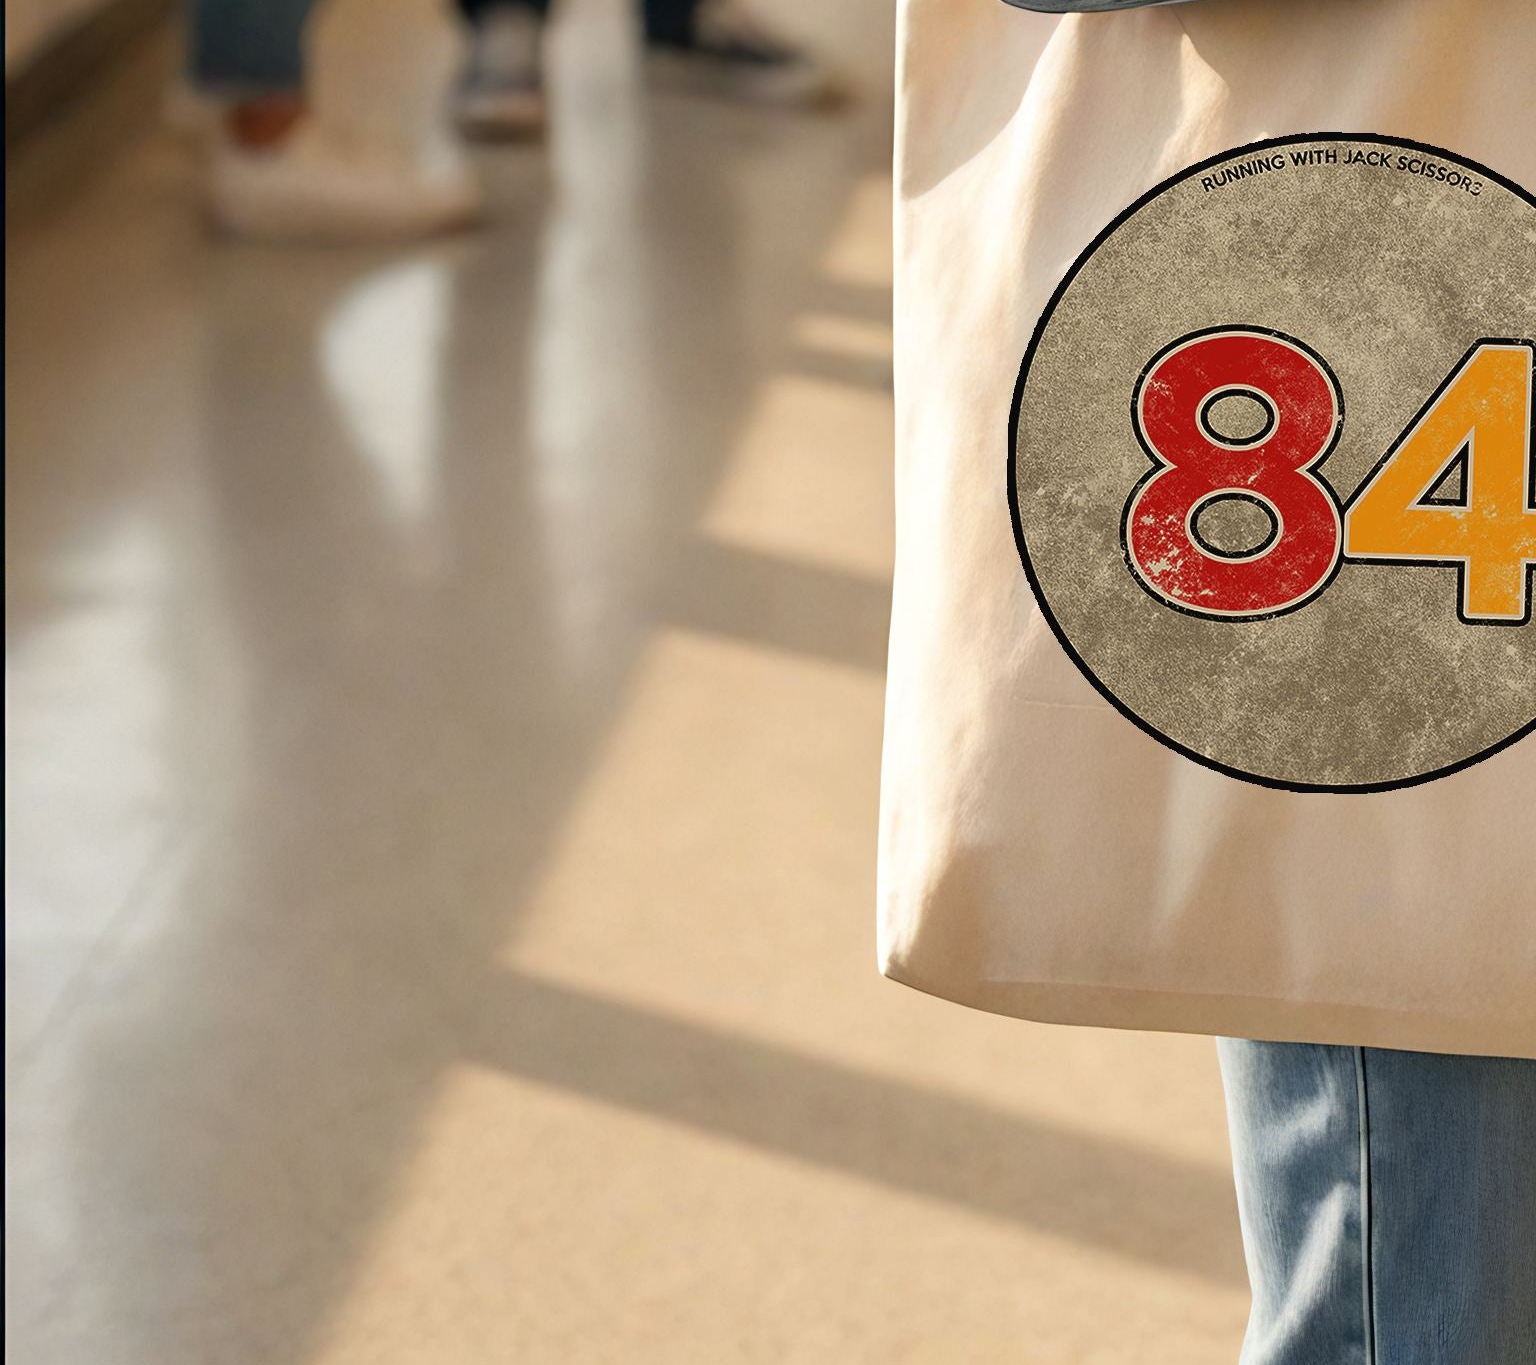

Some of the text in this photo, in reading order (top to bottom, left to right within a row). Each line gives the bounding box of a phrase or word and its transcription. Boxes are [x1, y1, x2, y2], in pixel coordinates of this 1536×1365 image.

[1201, 150, 1483, 196] RUNNING WITH JACK SCISSORS
